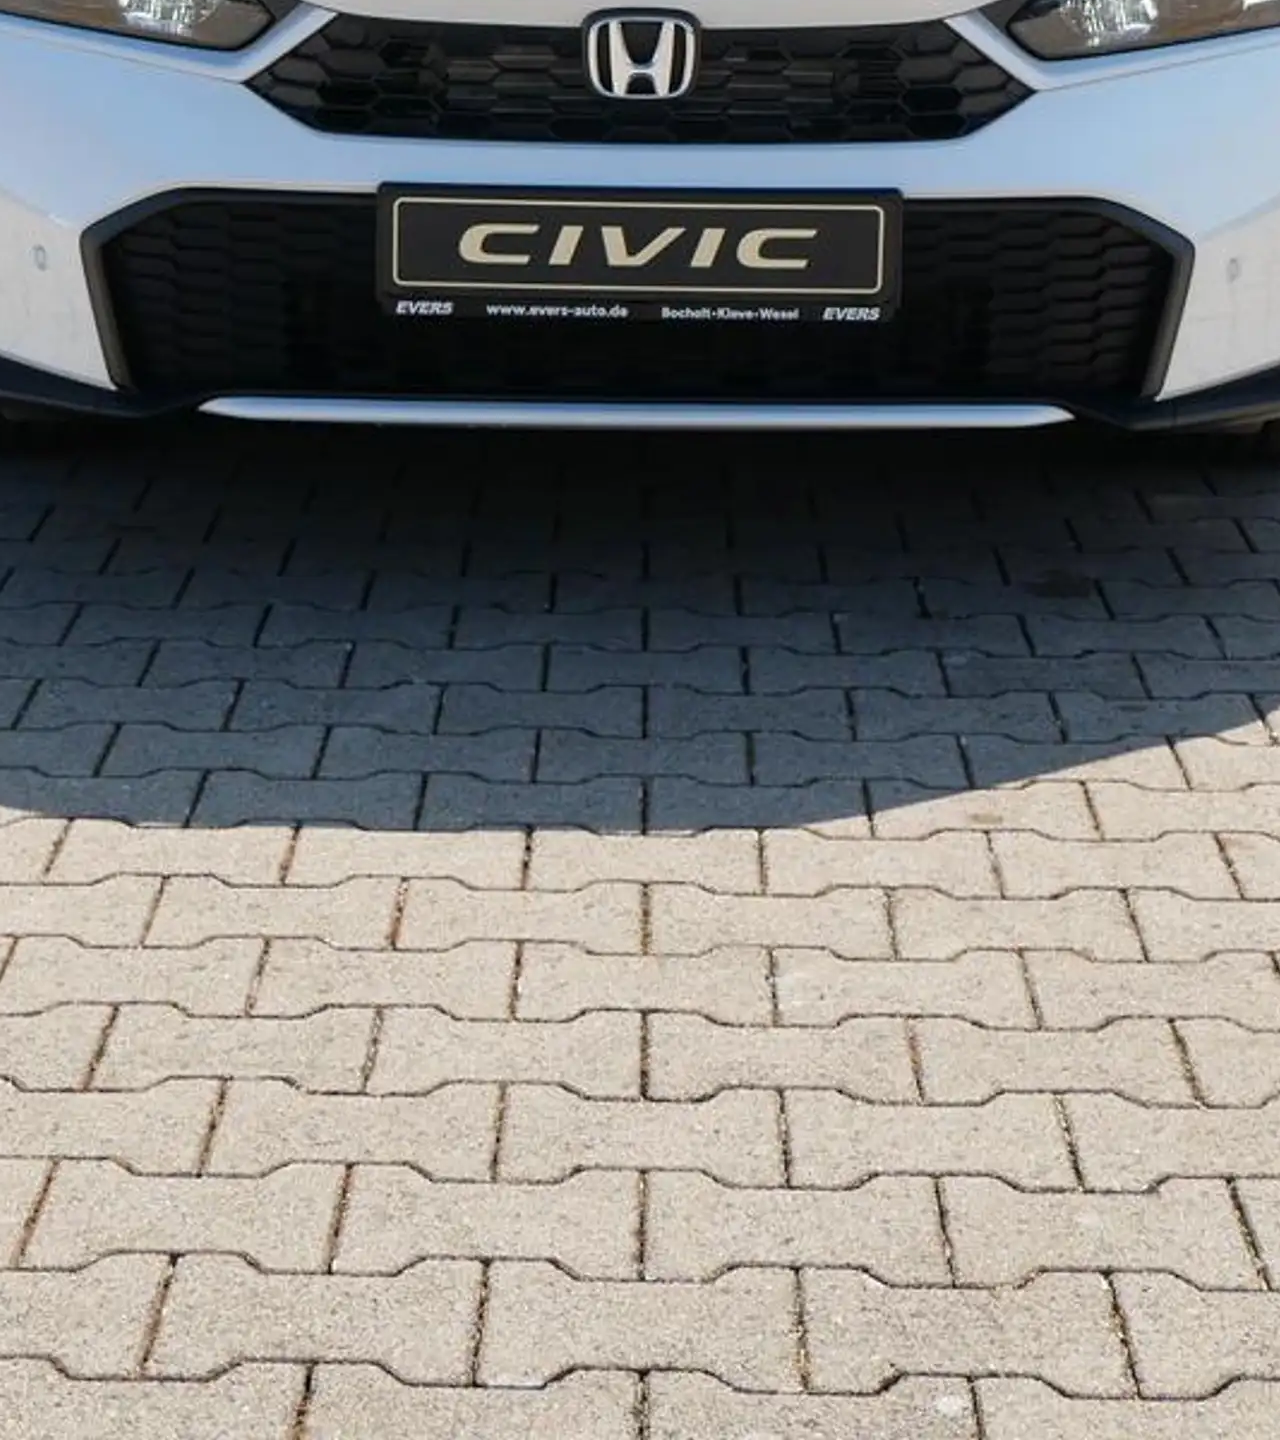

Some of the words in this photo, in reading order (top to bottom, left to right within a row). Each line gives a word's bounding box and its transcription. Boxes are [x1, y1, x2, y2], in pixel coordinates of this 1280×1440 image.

[458, 222, 819, 270] CIVIC
[395, 300, 455, 315] EVERS
[485, 304, 630, 319] www.evers-auto.de
[822, 306, 882, 322] EVERS
